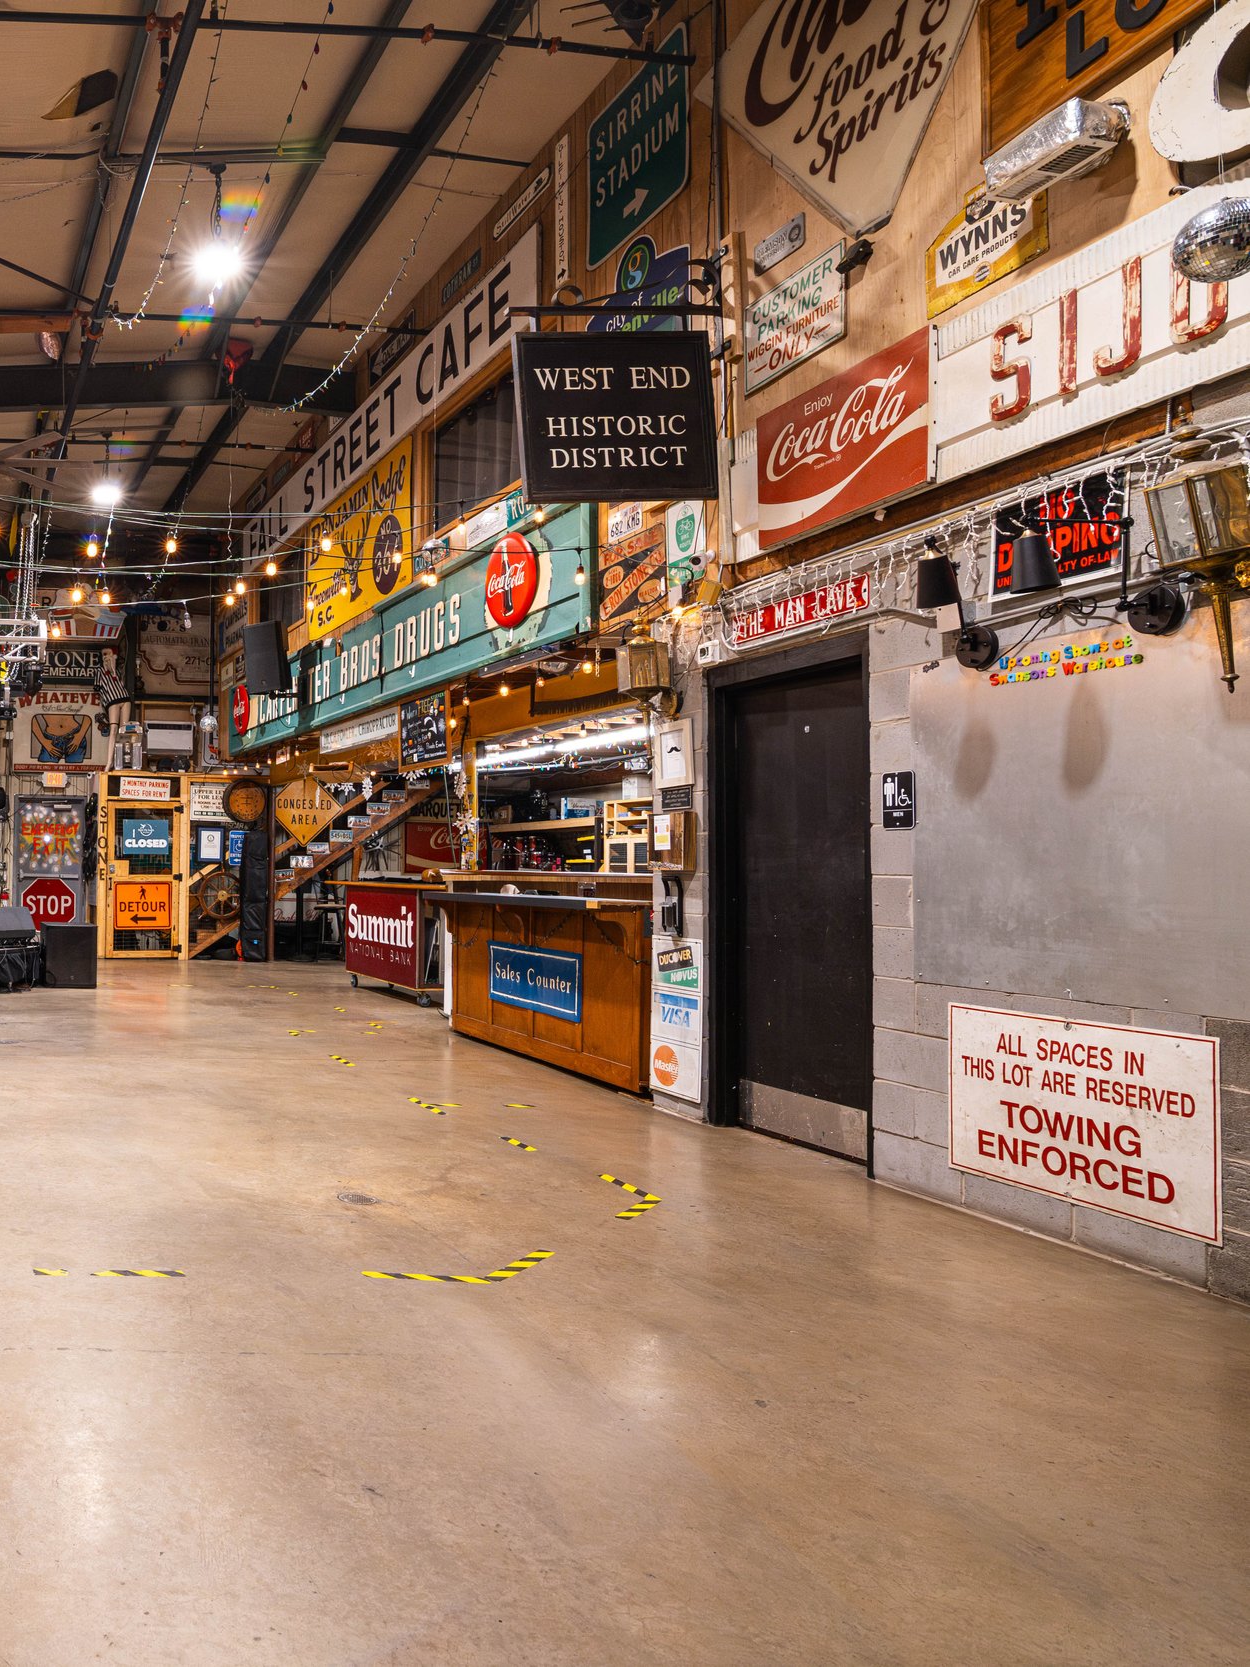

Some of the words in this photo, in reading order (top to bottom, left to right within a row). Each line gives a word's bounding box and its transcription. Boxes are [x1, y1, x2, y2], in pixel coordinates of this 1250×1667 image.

[795, 15, 907, 144] food
[596, 52, 678, 162] SIRRINE
[809, 38, 948, 184] Spirits
[596, 102, 679, 208] STADIUM
[948, 263, 961, 279] CAR
[962, 253, 980, 273] CARE
[981, 230, 1018, 262] PRODUCTS
[753, 257, 833, 325] CUSTOMER
[747, 331, 783, 363] WIGGIN
[786, 294, 841, 340] FURNITURE
[757, 286, 822, 342] PARKING
[769, 325, 815, 371] ONLY
[533, 367, 615, 391] WEST
[630, 366, 692, 390] END
[248, 497, 289, 559] FALL
[303, 374, 402, 513] STREET
[416, 262, 512, 405] CAFE
[765, 356, 915, 482] Coca-Cola
[804, 391, 834, 416] Enjoy
[546, 414, 687, 437] HISTORIC
[550, 446, 688, 469] DISTRICT
[310, 482, 370, 569] BENJAMIN
[371, 455, 406, 516] Lodge
[610, 519, 624, 538] 682
[626, 510, 640, 531] KMG
[603, 545, 624, 567] FOR
[625, 563, 652, 596] STONE
[738, 609, 765, 638] THE
[775, 596, 805, 629] MAN
[817, 582, 856, 616] CAVE
[394, 592, 461, 670] DRUGS
[989, 664, 1058, 688] Swansons
[1062, 652, 1145, 677] Warehouse
[998, 648, 1060, 672] Upcoming
[1063, 639, 1110, 660] Shows
[1112, 634, 1134, 651] at
[358, 712, 397, 736] CHIROPRACTOR
[46, 773, 64, 786] EXIT
[127, 780, 147, 788] MONTHLY
[149, 781, 169, 789] PARKING
[277, 798, 332, 811] CONGESED
[290, 813, 318, 825] AREA
[22, 822, 80, 836] EMERGENCY
[124, 838, 168, 849] CLOSED
[33, 837, 69, 856] EXIT
[26, 895, 72, 915] STOP
[119, 901, 167, 913] DETOUR
[348, 903, 414, 948] Summit
[349, 940, 385, 961] NATIONAL
[390, 946, 412, 966] BANK
[658, 949, 692, 966] DISCOVER
[495, 961, 521, 984] Sales
[527, 966, 573, 995] Counter
[670, 967, 698, 984] NOVUS
[660, 1005, 691, 1028] VISA
[997, 1033, 1027, 1058] ALL
[1036, 1038, 1113, 1070] SPACES
[1124, 1051, 1144, 1076] IN
[961, 1054, 995, 1082] THIS
[1002, 1061, 1034, 1090] LOT
[1040, 1068, 1077, 1097] ARE
[1086, 1076, 1196, 1118] RESERVED
[1000, 1100, 1141, 1157] TOWING
[978, 1130, 1175, 1204] ENFORCED
